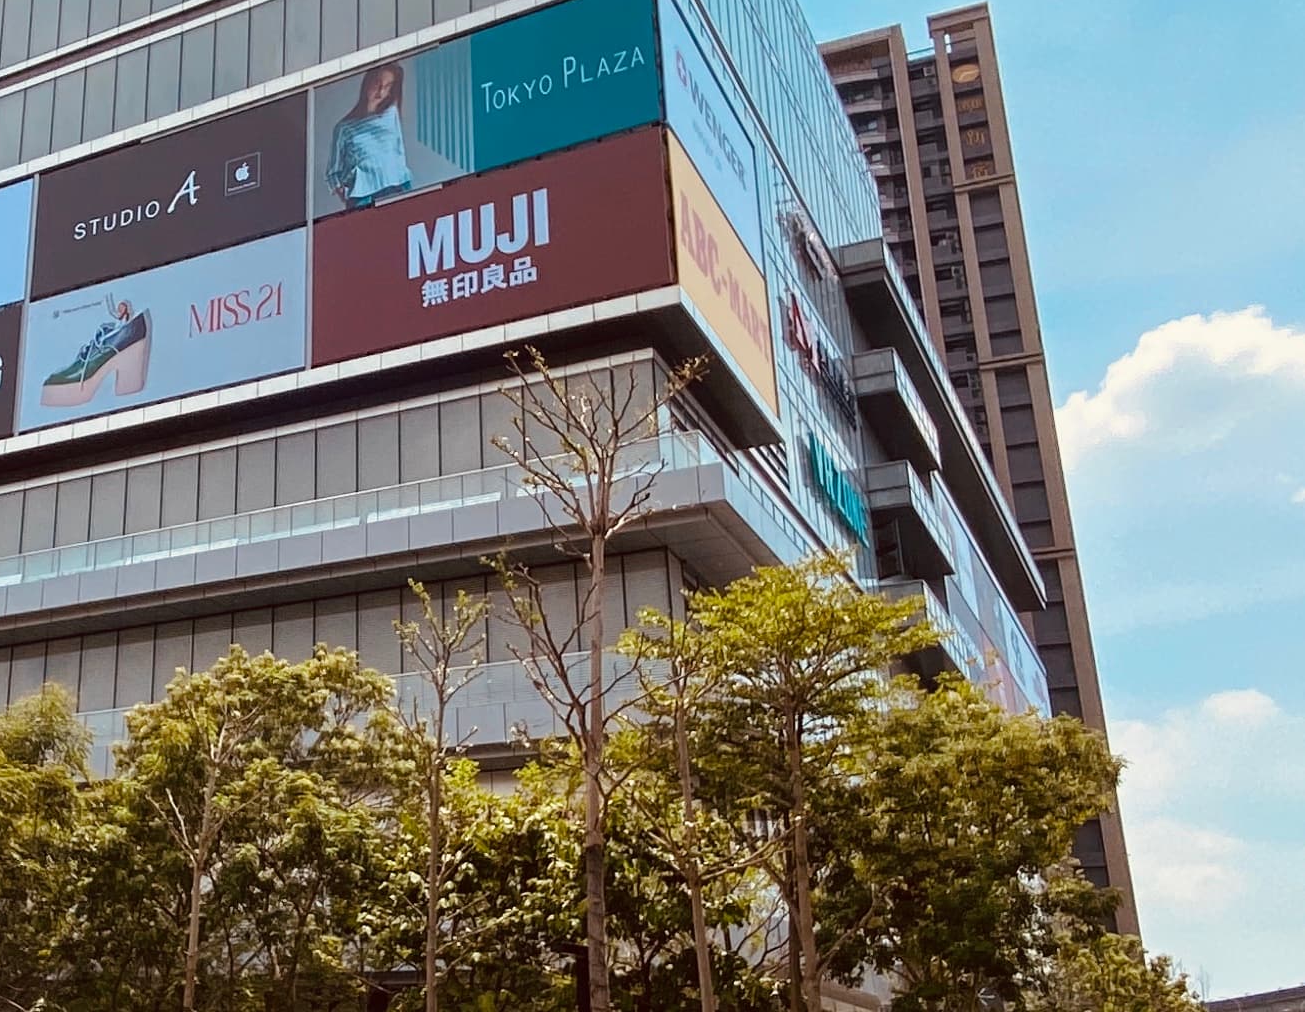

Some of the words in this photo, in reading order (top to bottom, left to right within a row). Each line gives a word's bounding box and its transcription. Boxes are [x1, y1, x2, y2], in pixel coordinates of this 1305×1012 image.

[73, 200, 161, 240] STUDIO
[167, 170, 201, 214] A
[407, 188, 550, 279] MUJI
[422, 256, 538, 308] 無印良品
[680, 190, 770, 364] ABC-MART
